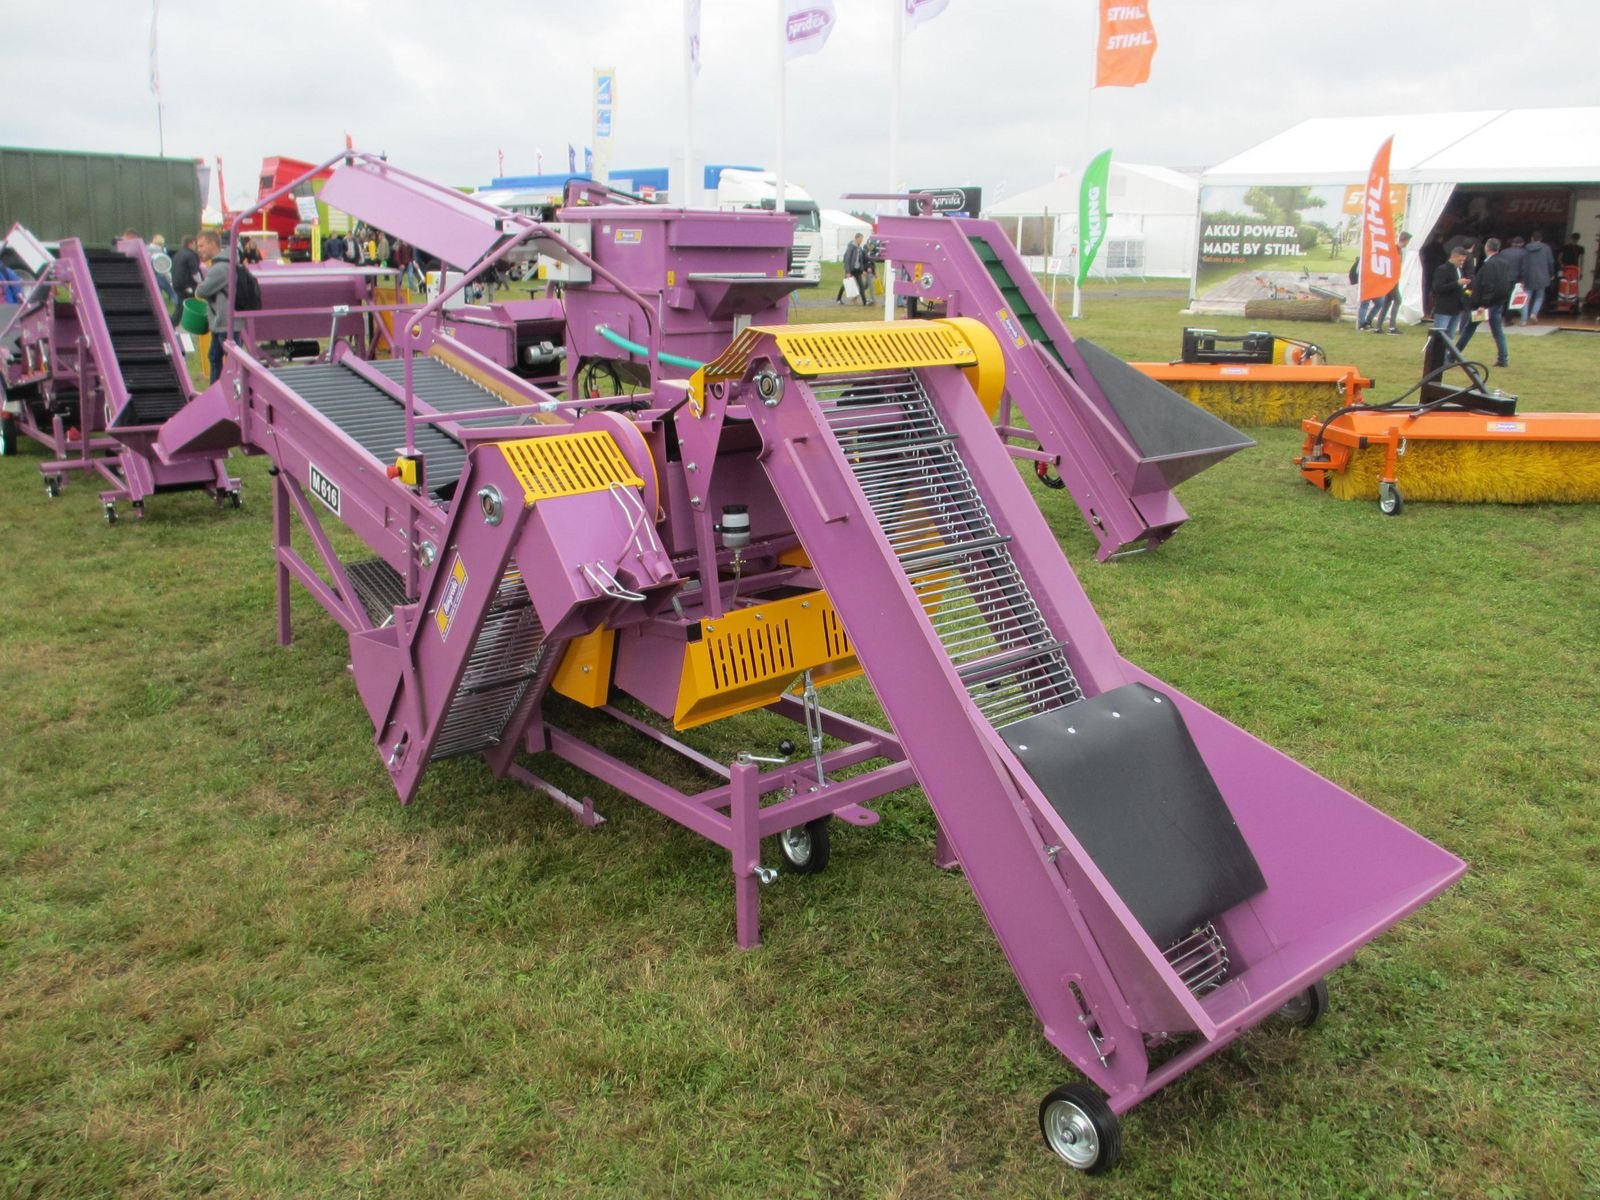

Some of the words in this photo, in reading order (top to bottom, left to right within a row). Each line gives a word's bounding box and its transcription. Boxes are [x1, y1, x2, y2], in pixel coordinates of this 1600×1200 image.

[1107, 5, 1146, 21] STIHL
[1104, 30, 1153, 50] STIHL
[1347, 190, 1399, 205] STL
[1506, 199, 1564, 213] STIHL
[1084, 186, 1101, 257] VIKING
[1366, 176, 1393, 279] STIHL
[1204, 225, 1241, 237] AKKU
[1243, 225, 1298, 238] POWER.
[1203, 242, 1240, 255] MADE
[1242, 243, 1262, 256] BY
[1263, 243, 1308, 256] STIHL.
[312, 470, 321, 493] M
[321, 479, 338, 507] 616
